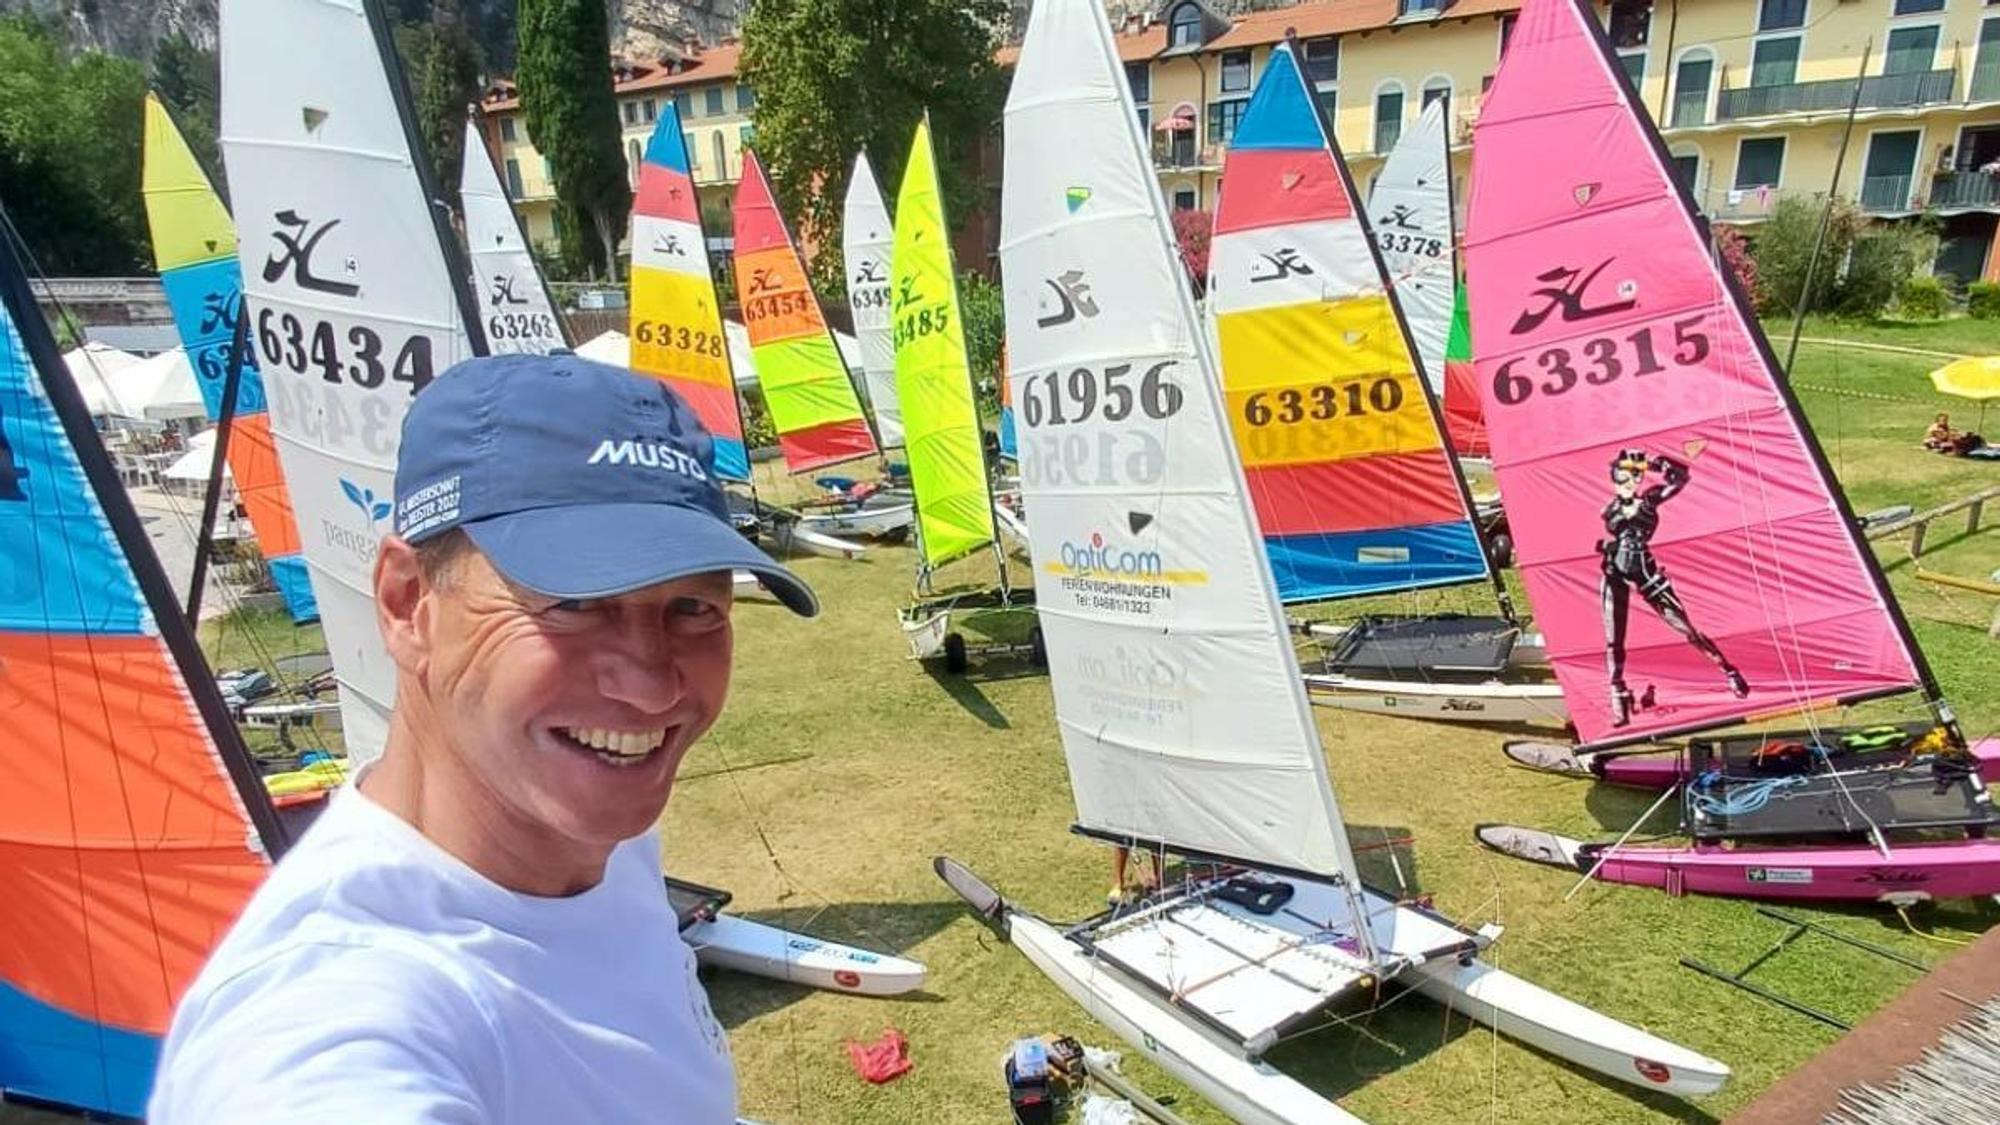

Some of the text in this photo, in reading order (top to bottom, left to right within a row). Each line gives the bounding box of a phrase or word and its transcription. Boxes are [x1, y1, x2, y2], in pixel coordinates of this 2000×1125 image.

[490, 313, 554, 340] 63263
[746, 290, 809, 321] 63454
[894, 304, 948, 352] 3485
[259, 307, 434, 397] 63434
[636, 320, 721, 358] 63328
[1493, 314, 1710, 406] 63315
[1023, 360, 1183, 428] 61956
[1245, 377, 1403, 427] 63310
[587, 439, 708, 481] MUSTO
[1061, 533, 1162, 577] OptiCom
